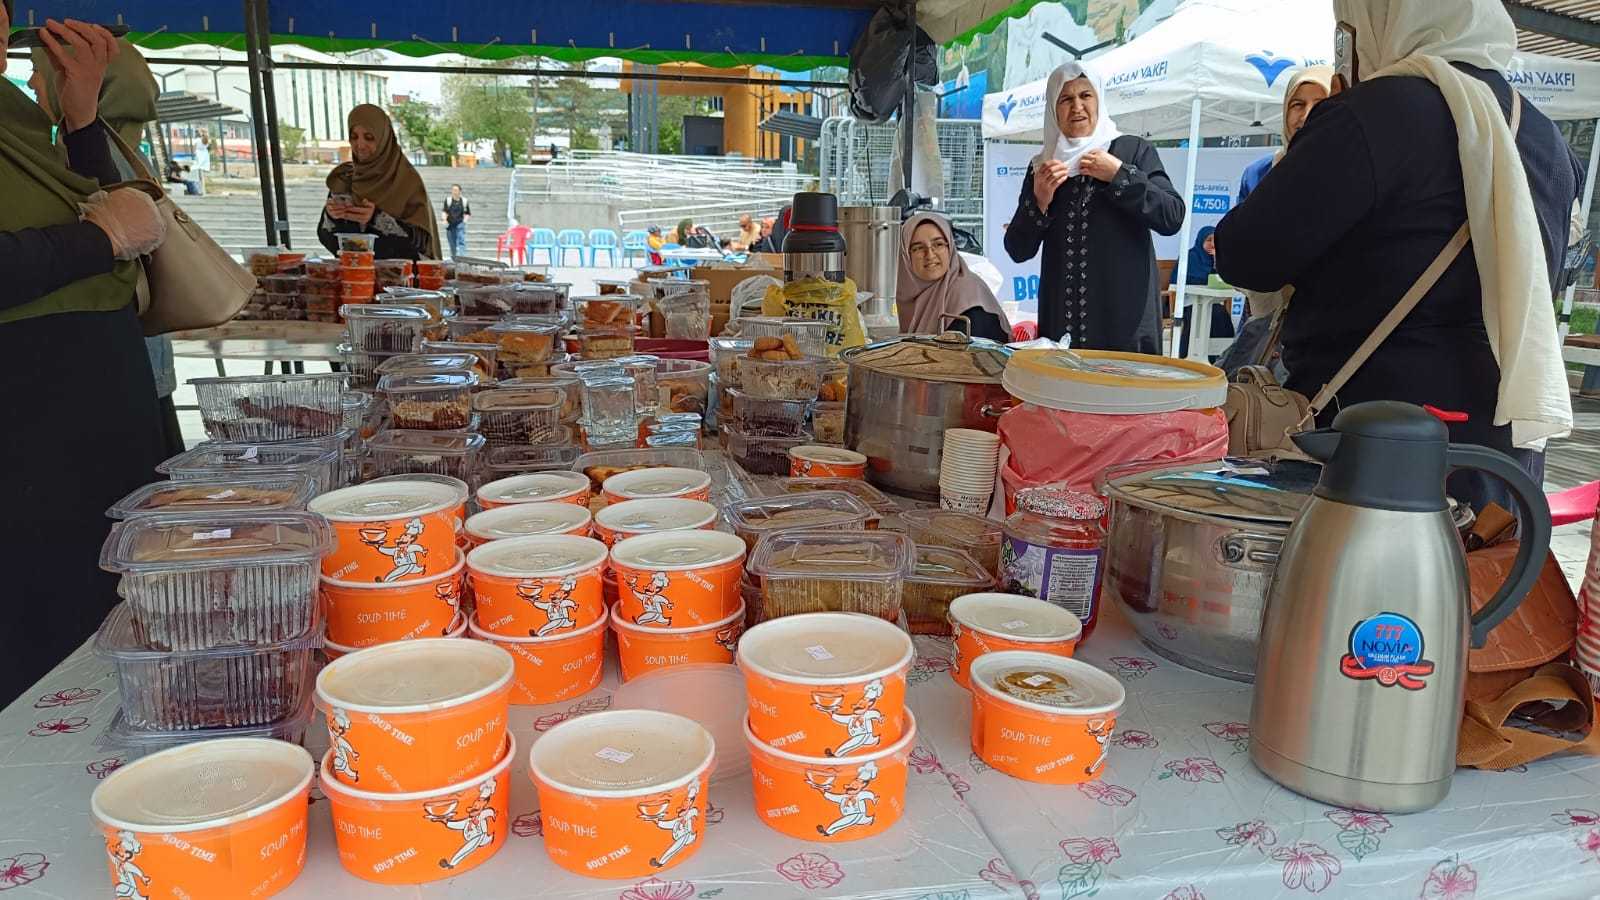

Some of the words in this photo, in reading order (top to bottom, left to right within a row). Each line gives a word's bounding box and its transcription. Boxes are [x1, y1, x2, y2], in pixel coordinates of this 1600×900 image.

[1141, 60, 1168, 77] VAKFI
[1507, 70, 1533, 84] SAN
[1535, 71, 1575, 87] VAKFI
[1012, 274, 1040, 301] BA
[357, 612, 382, 625] SOUP
[384, 609, 408, 622] TIME
[1375, 623, 1403, 640] 777
[1361, 639, 1413, 653] NOVİA
[644, 655, 667, 665] SOUP
[668, 654, 689, 664] TIME
[367, 713, 392, 732] SOUP
[391, 728, 416, 747] TIME
[456, 728, 484, 750] SOUP
[1000, 727, 1026, 744] SOUP
[1028, 734, 1052, 747] TIME
[1034, 762, 1056, 776] SOUP
[1055, 753, 1077, 768] TIME
[337, 818, 357, 837] SOUP
[359, 827, 382, 841] TIME
[549, 815, 570, 833] SOUP
[572, 823, 598, 839] TIME
[161, 833, 192, 852] SOUP
[190, 847, 218, 864] TIME
[259, 835, 289, 861] SOUP
[586, 855, 610, 871] SOUP
[609, 844, 632, 862] TIME
[373, 858, 396, 874] SOUP
[395, 847, 418, 865] TIME
